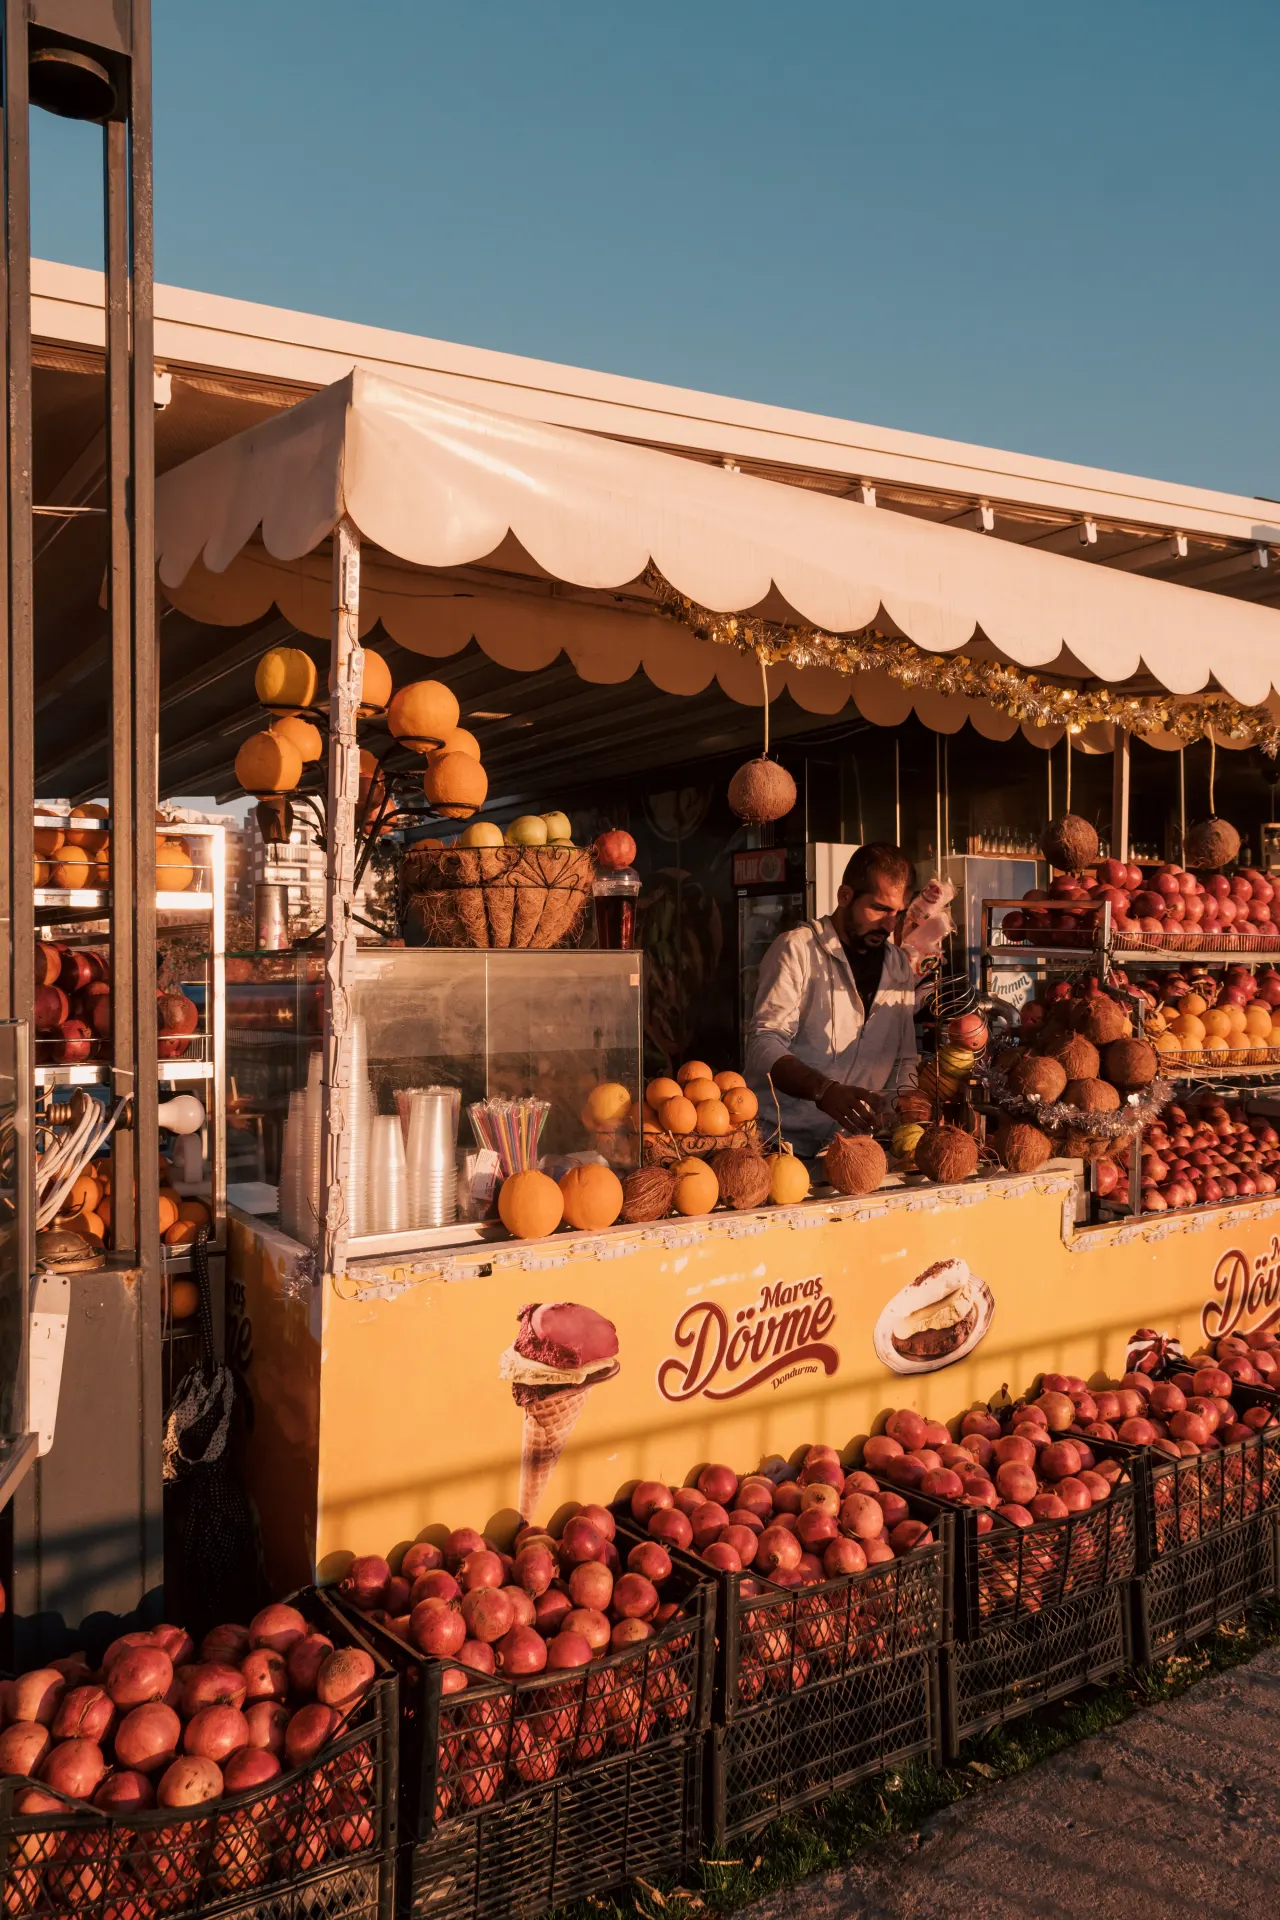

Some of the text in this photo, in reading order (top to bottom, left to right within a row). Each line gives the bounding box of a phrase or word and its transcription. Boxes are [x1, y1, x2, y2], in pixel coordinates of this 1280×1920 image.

[759, 1276, 823, 1313] Maraş
[658, 1296, 836, 1402] Dövme
[770, 1364, 819, 1390] Dondurma
